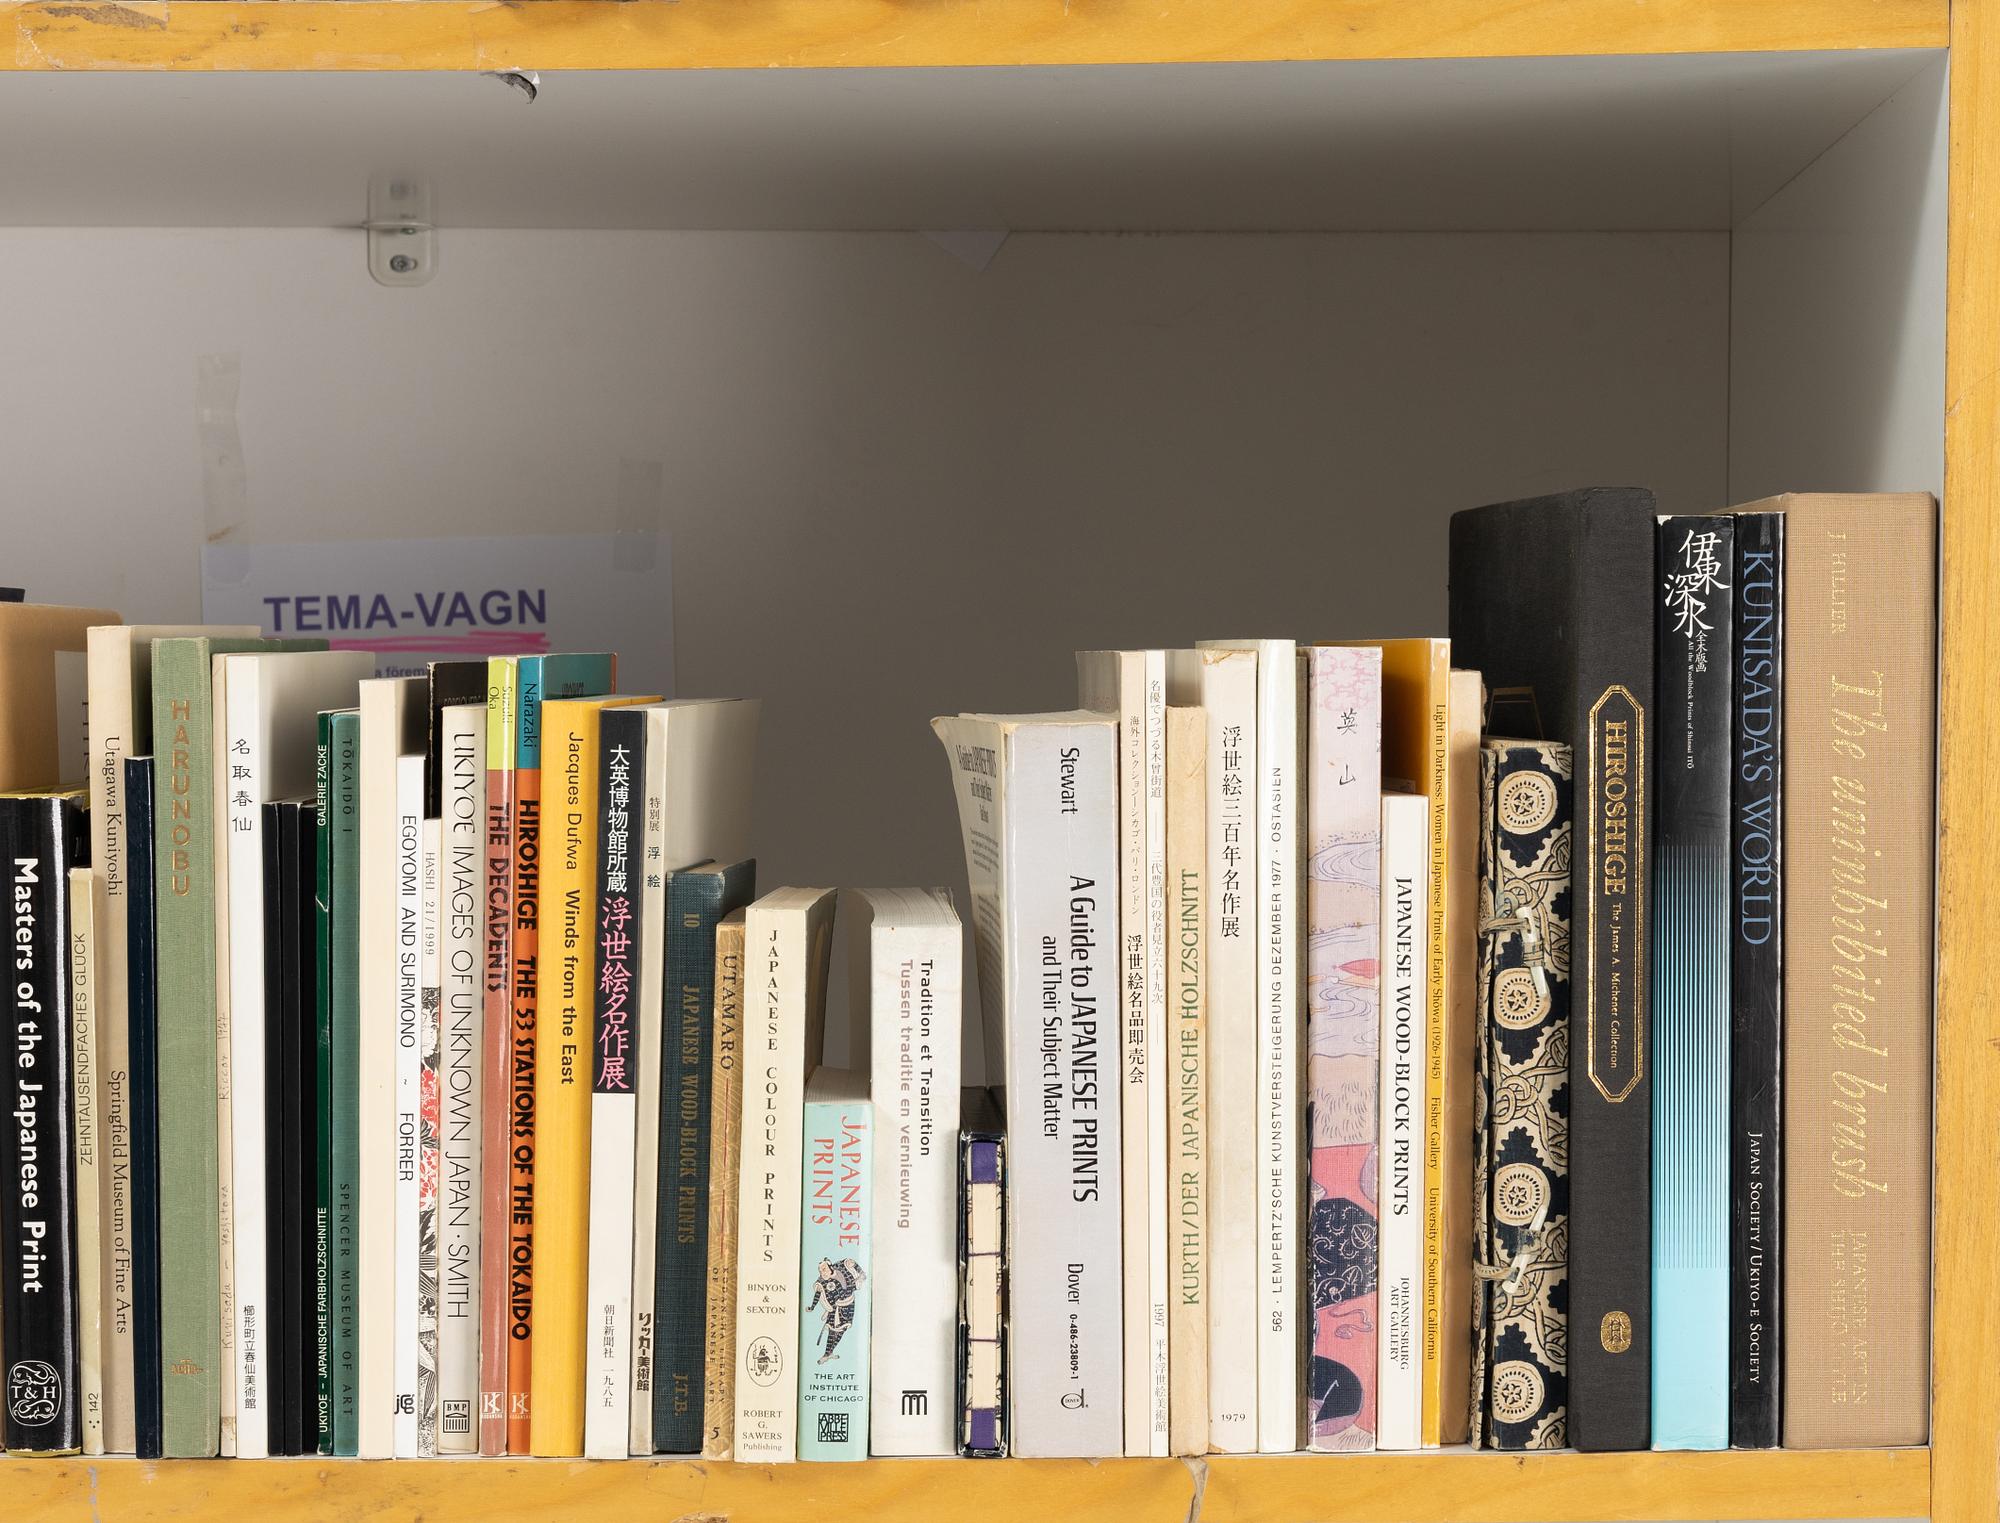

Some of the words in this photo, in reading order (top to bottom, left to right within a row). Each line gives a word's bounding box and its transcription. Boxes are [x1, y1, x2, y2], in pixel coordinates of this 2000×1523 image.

[263, 588, 548, 632] TEMA-VAGN
[1664, 529, 1731, 638] 伊東深水
[1831, 552, 1847, 634] HILLIER
[1686, 664, 1695, 699] Woodblock
[1694, 630, 1708, 673] 全木版画
[1741, 550, 1774, 784] KUNISADA'S
[488, 686, 499, 711] Oka
[522, 682, 538, 748] Narazaki
[1433, 704, 1446, 732] Light
[1831, 669, 1889, 760] The
[102, 736, 120, 808] Utagawa
[317, 744, 327, 778] ZACKE
[567, 732, 584, 805] Jacques
[1337, 707, 1359, 786] 英山
[1434, 749, 1446, 801] Darkness:
[171, 699, 191, 897] HARUNOBU
[231, 738, 253, 833] 名取春仙
[317, 779, 327, 827] GALERIE
[453, 731, 476, 834] UKIYOE
[1060, 746, 1080, 815] Stewart
[1271, 767, 1282, 842] OSTASIEN
[1604, 720, 1628, 895] HIROSHIGE
[488, 802, 511, 845] THE
[566, 814, 583, 870] Dufwa
[606, 744, 630, 893] 大英博物館所蔵
[648, 796, 661, 832] 特別展
[1221, 725, 1244, 939] 浮世絵三百年名作展
[1434, 803, 1445, 845] Women
[104, 813, 123, 897] Kuniyoshi
[402, 815, 417, 896] EGOYOMI
[425, 851, 436, 890] HASHI
[517, 799, 540, 931] HIROSHIGE
[1069, 874, 1096, 892] A
[1271, 859, 1282, 888] 1977
[1431, 860, 1444, 907] Japanese
[1740, 793, 1773, 946] WORLD
[14, 857, 39, 970] Masters
[452, 845, 475, 940] IMAGES
[564, 889, 581, 949] Winds
[1611, 902, 1622, 922] The
[1831, 775, 1889, 1058] uninhibited
[401, 907, 416, 948] AND
[424, 901, 436, 956] 21/1999
[487, 858, 511, 992] DECADENTS
[1043, 936, 1062, 966] and
[1070, 897, 1096, 961] Guide
[1181, 868, 1200, 1020] HOLZSCHNITT
[1271, 892, 1282, 976] DEZEMBER
[1395, 876, 1413, 978] JAPANESE
[1433, 910, 1444, 941] Prints
[1608, 925, 1622, 954] James
[74, 933, 86, 986] GLÜCK
[451, 950, 474, 985] OF
[516, 956, 536, 999] THE
[563, 955, 580, 999] from
[767, 929, 779, 1051] JAPANESE
[900, 959, 913, 1019] Tussen
[1071, 966, 1093, 988] to
[1430, 958, 1443, 985] Early
[17, 982, 42, 1013] of
[400, 953, 416, 1049] SURIMONO
[515, 1008, 536, 1031] 53
[562, 1005, 579, 1037] the
[597, 896, 633, 1090] 浮世絵名作展
[720, 954, 738, 1071] UTAMARO
[920, 959, 933, 1038] Tradition
[1043, 972, 1063, 1014] Their
[1127, 934, 1145, 1085] 浮世絵名品即売会
[1609, 972, 1622, 1017] Michener
[18, 1018, 43, 1069] the
[682, 985, 700, 1066] JAPANESE
[920, 1043, 932, 1062] et
[1040, 1016, 1063, 1080] Subject
[1070, 991, 1098, 1111] JAPANESE
[1430, 1026, 1442, 1080] (1926-1945)
[1609, 1021, 1622, 1069] Collection
[75, 992, 93, 1166] ZEHNTAUSENDFACHES
[449, 993, 473, 1143] UNKNOWN
[514, 1038, 536, 1140] STATIONS
[560, 1042, 577, 1085] East
[900, 1025, 913, 1091] traditie
[1272, 983, 1283, 1163] KUNSTVERSTEIGERUNG
[1393, 984, 1413, 1134] WOOD-BLOCK
[107, 1070, 128, 1158] Springfield
[678, 1069, 700, 1178] WOOD-BLOCK
[765, 1067, 778, 1157] COLOUR
[900, 1098, 911, 1117] en
[920, 1067, 933, 1157] Transition
[1042, 1082, 1063, 1140] Matter
[1181, 1028, 1200, 1160] JAPANISCHE
[1431, 1096, 1441, 1129] Fisher
[13, 1081, 43, 1209] Japanese
[399, 1112, 414, 1182] FORRER
[513, 1145, 534, 1176] OF
[1072, 1117, 1099, 1204] PRINTS
[1427, 1131, 1441, 1170] Gallery
[1831, 1070, 1889, 1199] brush
[113, 1164, 130, 1232] Museum
[445, 1151, 471, 1228] JAPAN
[512, 1183, 533, 1226] THE
[811, 1137, 835, 1226] PRINTS
[838, 1115, 867, 1248] JAPANESE
[897, 1124, 913, 1230] vernieuwing
[1393, 1142, 1410, 1216] PRINTS
[339, 1183, 350, 1257] SPENCER
[676, 1186, 697, 1245] PRINTS
[763, 1173, 776, 1263] PRINTS
[1272, 1167, 1283, 1294] LEMPERTZ'SCHE
[1427, 1187, 1440, 1241] University
[22, 1221, 46, 1294] Print
[115, 1256, 131, 1293] Fine
[317, 1207, 327, 1306] FARBHOLZSCHNITTE
[448, 1244, 470, 1319] SMITH
[511, 1236, 534, 1341] TOKAIDO
[747, 1283, 787, 1292] BINYON
[1066, 1262, 1085, 1306] Dover
[1427, 1258, 1439, 1306] Southern
[116, 1299, 132, 1335] Arts
[341, 1270, 351, 1335] MUSEUM
[746, 1306, 786, 1314] SEXTON
[1154, 1303, 1165, 1328] 1997
[1273, 1310, 1283, 1332] 562
[1390, 1285, 1399, 1313] ART
[1400, 1276, 1410, 1371] JOHANNESBURG
[317, 1307, 328, 1379] JAPANISCHE
[342, 1350, 352, 1370] OF
[602, 1304, 615, 1359] 朝日新聞社
[636, 1312, 652, 1392] リッカー美術館
[1069, 1313, 1079, 1380] 0-486-23809-1
[1390, 1315, 1399, 1362] GALLERY
[1426, 1308, 1438, 1361] California
[88, 1392, 99, 1412] 142
[319, 1393, 328, 1433] UKIYOE
[342, 1383, 353, 1417] ART
[602, 1369, 614, 1408] 一九八五
[743, 1410, 783, 1418] ROBERT
[1220, 1412, 1247, 1422] 1979
[742, 1432, 783, 1440] SAWERS
[743, 1443, 782, 1452] Publishing
